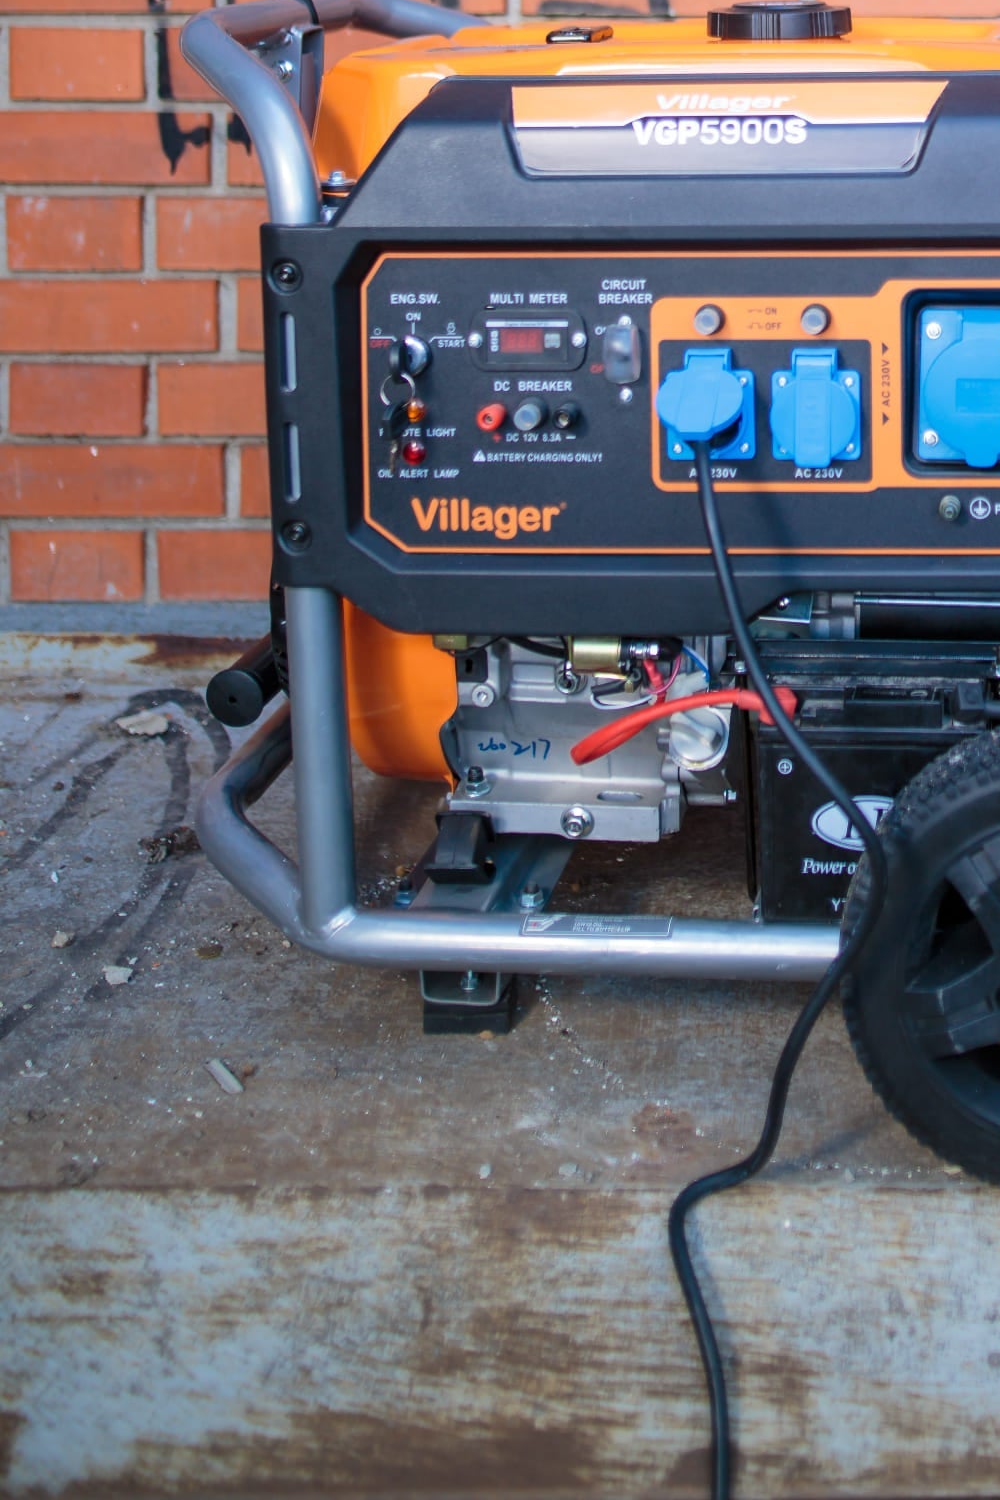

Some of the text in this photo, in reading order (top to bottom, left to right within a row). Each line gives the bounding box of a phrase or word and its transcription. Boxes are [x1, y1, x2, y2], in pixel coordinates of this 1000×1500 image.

[656, 94, 791, 111] Villager
[632, 118, 807, 145] VGP5900S
[602, 280, 646, 290] CIRCUIT
[390, 294, 440, 304] ENG.SW.
[490, 294, 568, 304] MULTI METER
[598, 294, 653, 304] BREAKER
[405, 312, 421, 321] ON
[437, 340, 465, 348] START
[494, 381, 572, 391] DC BREAKER
[881, 360, 891, 407] AC 230V
[426, 428, 456, 437] LIGHT
[506, 433, 562, 442] DC 12V 8.3A
[487, 453, 602, 463] BATTERY CHARGING ONLY!
[378, 469, 460, 478] OIL ALERT LAMP
[795, 468, 843, 478] AC 230V
[411, 498, 561, 539] Villager
[801, 858, 847, 875] Power
